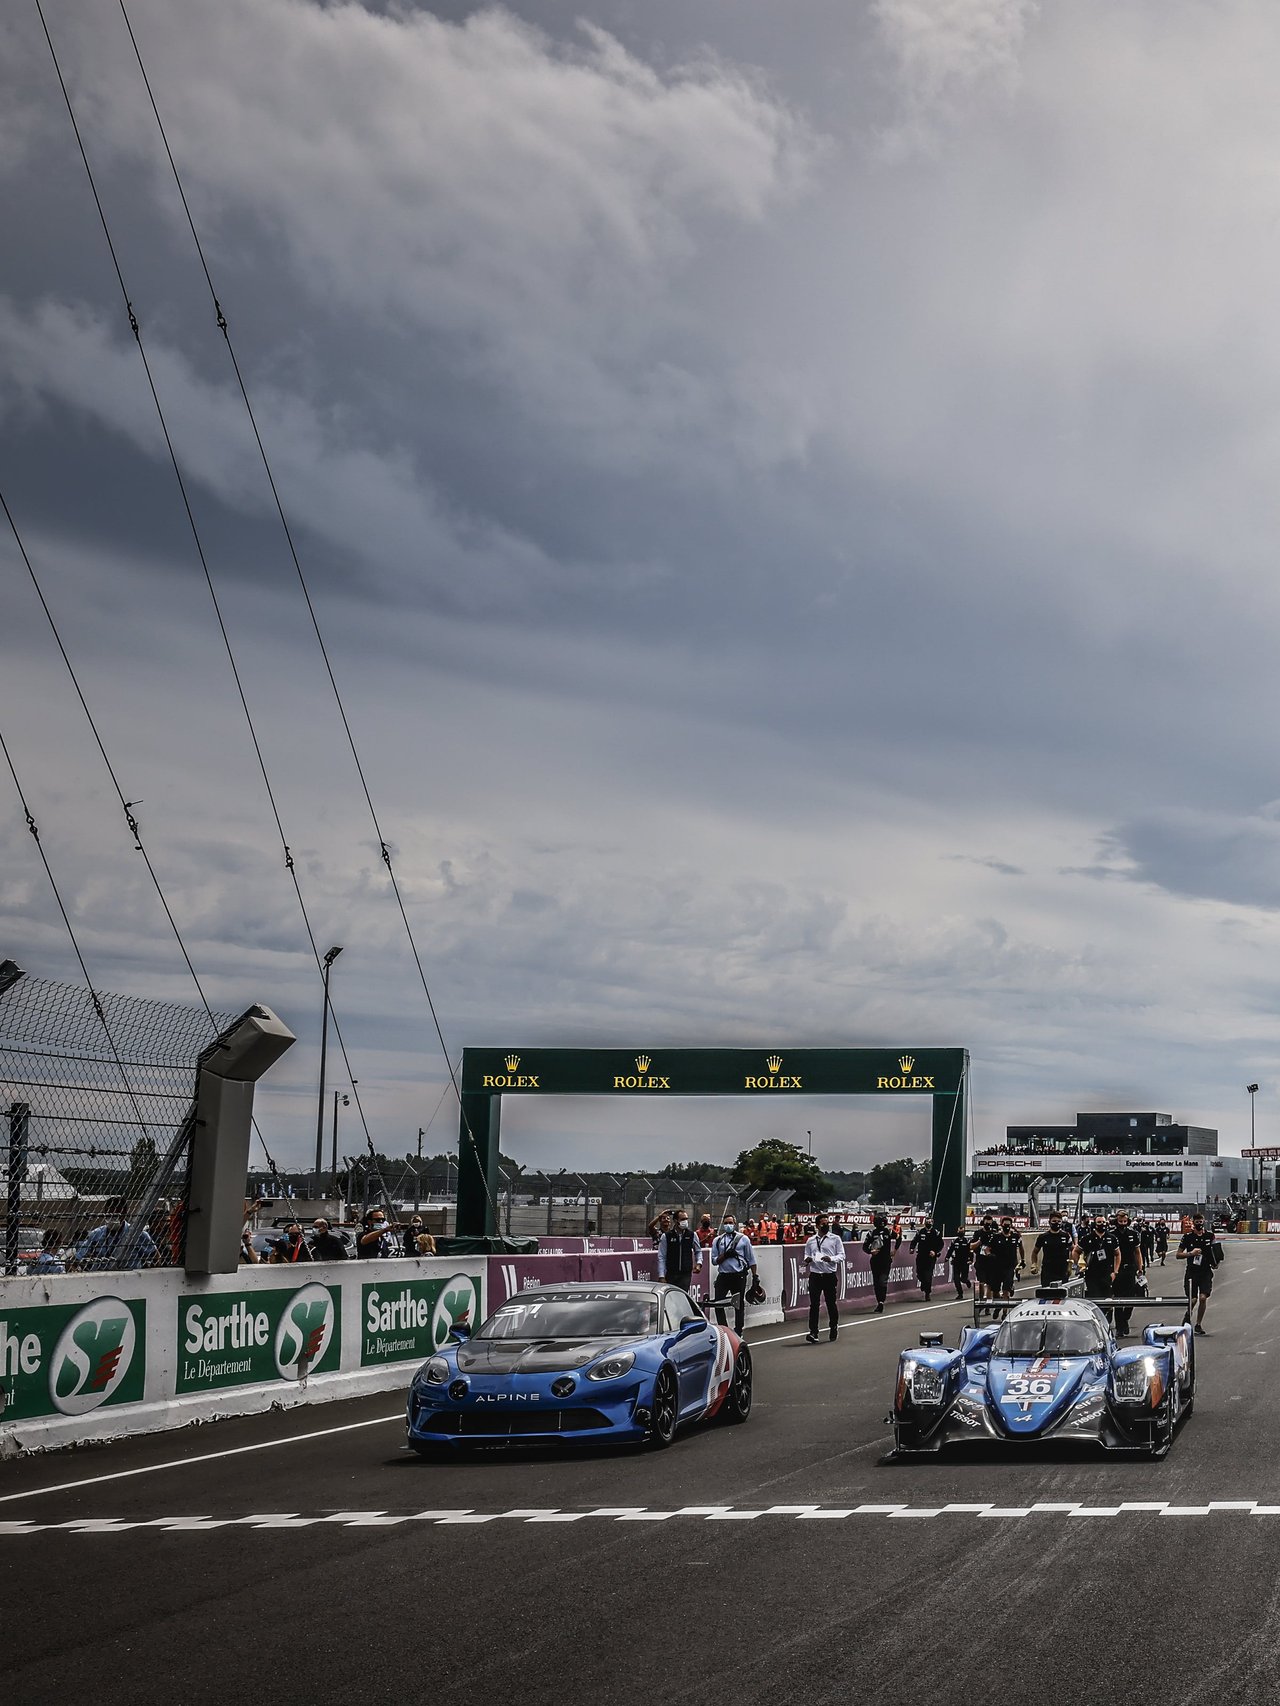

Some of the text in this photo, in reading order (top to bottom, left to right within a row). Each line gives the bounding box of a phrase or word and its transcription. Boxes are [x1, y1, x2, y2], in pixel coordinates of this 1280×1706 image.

[482, 1075, 540, 1088] ROLEX
[613, 1076, 671, 1089] ROLEX
[744, 1076, 802, 1089] ROLEX
[877, 1076, 935, 1089] ROLEX
[1126, 1160, 1155, 1168] Experience
[533, 1293, 630, 1302] ALPINE
[366, 1289, 428, 1333] Sarthe
[1015, 1309, 1080, 1317] Matmt
[185, 1301, 269, 1354] Sarthe
[366, 1336, 416, 1357] Le Département
[184, 1357, 252, 1382] Le Département
[1007, 1379, 1052, 1395] 36
[475, 1393, 540, 1403] ALPINE
[950, 1410, 981, 1428] TISSOT
[1071, 1408, 1107, 1427] TISSOT
